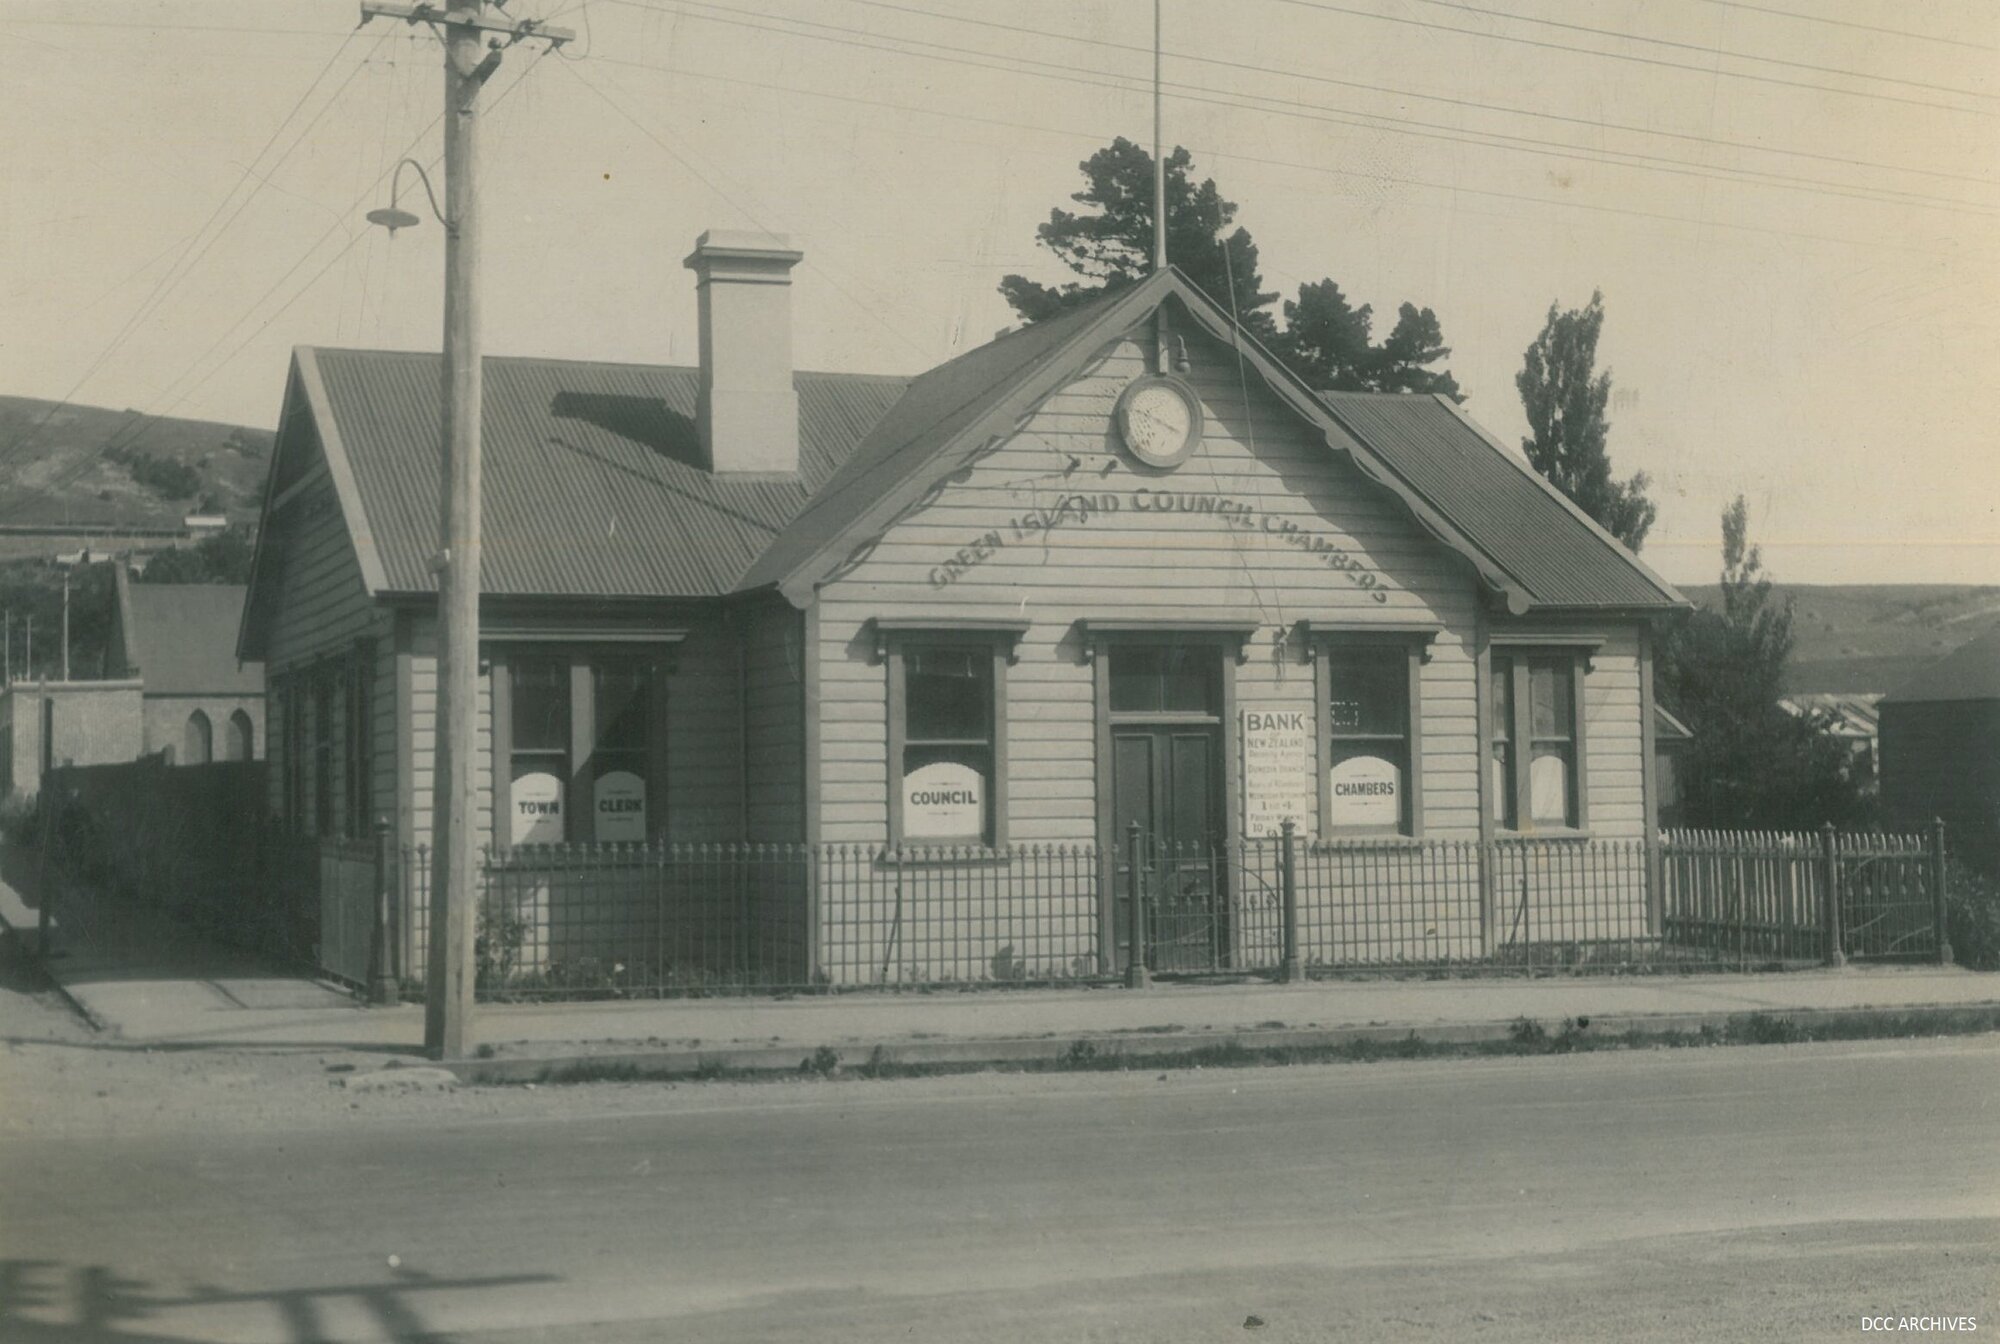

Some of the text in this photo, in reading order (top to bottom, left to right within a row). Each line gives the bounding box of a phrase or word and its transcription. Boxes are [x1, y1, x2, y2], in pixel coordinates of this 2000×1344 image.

[929, 488, 1388, 604] GREEN ISLAND COUNCIL CHAMBERS
[1247, 713, 1304, 731] BANK
[1247, 737, 1304, 749] NEW ZEALAND
[1335, 782, 1394, 796] CHAMBERS
[911, 790, 977, 805] COUNCIL
[518, 801, 560, 815] TOWN
[599, 799, 642, 812] CLERK
[1252, 822, 1263, 833] 10
